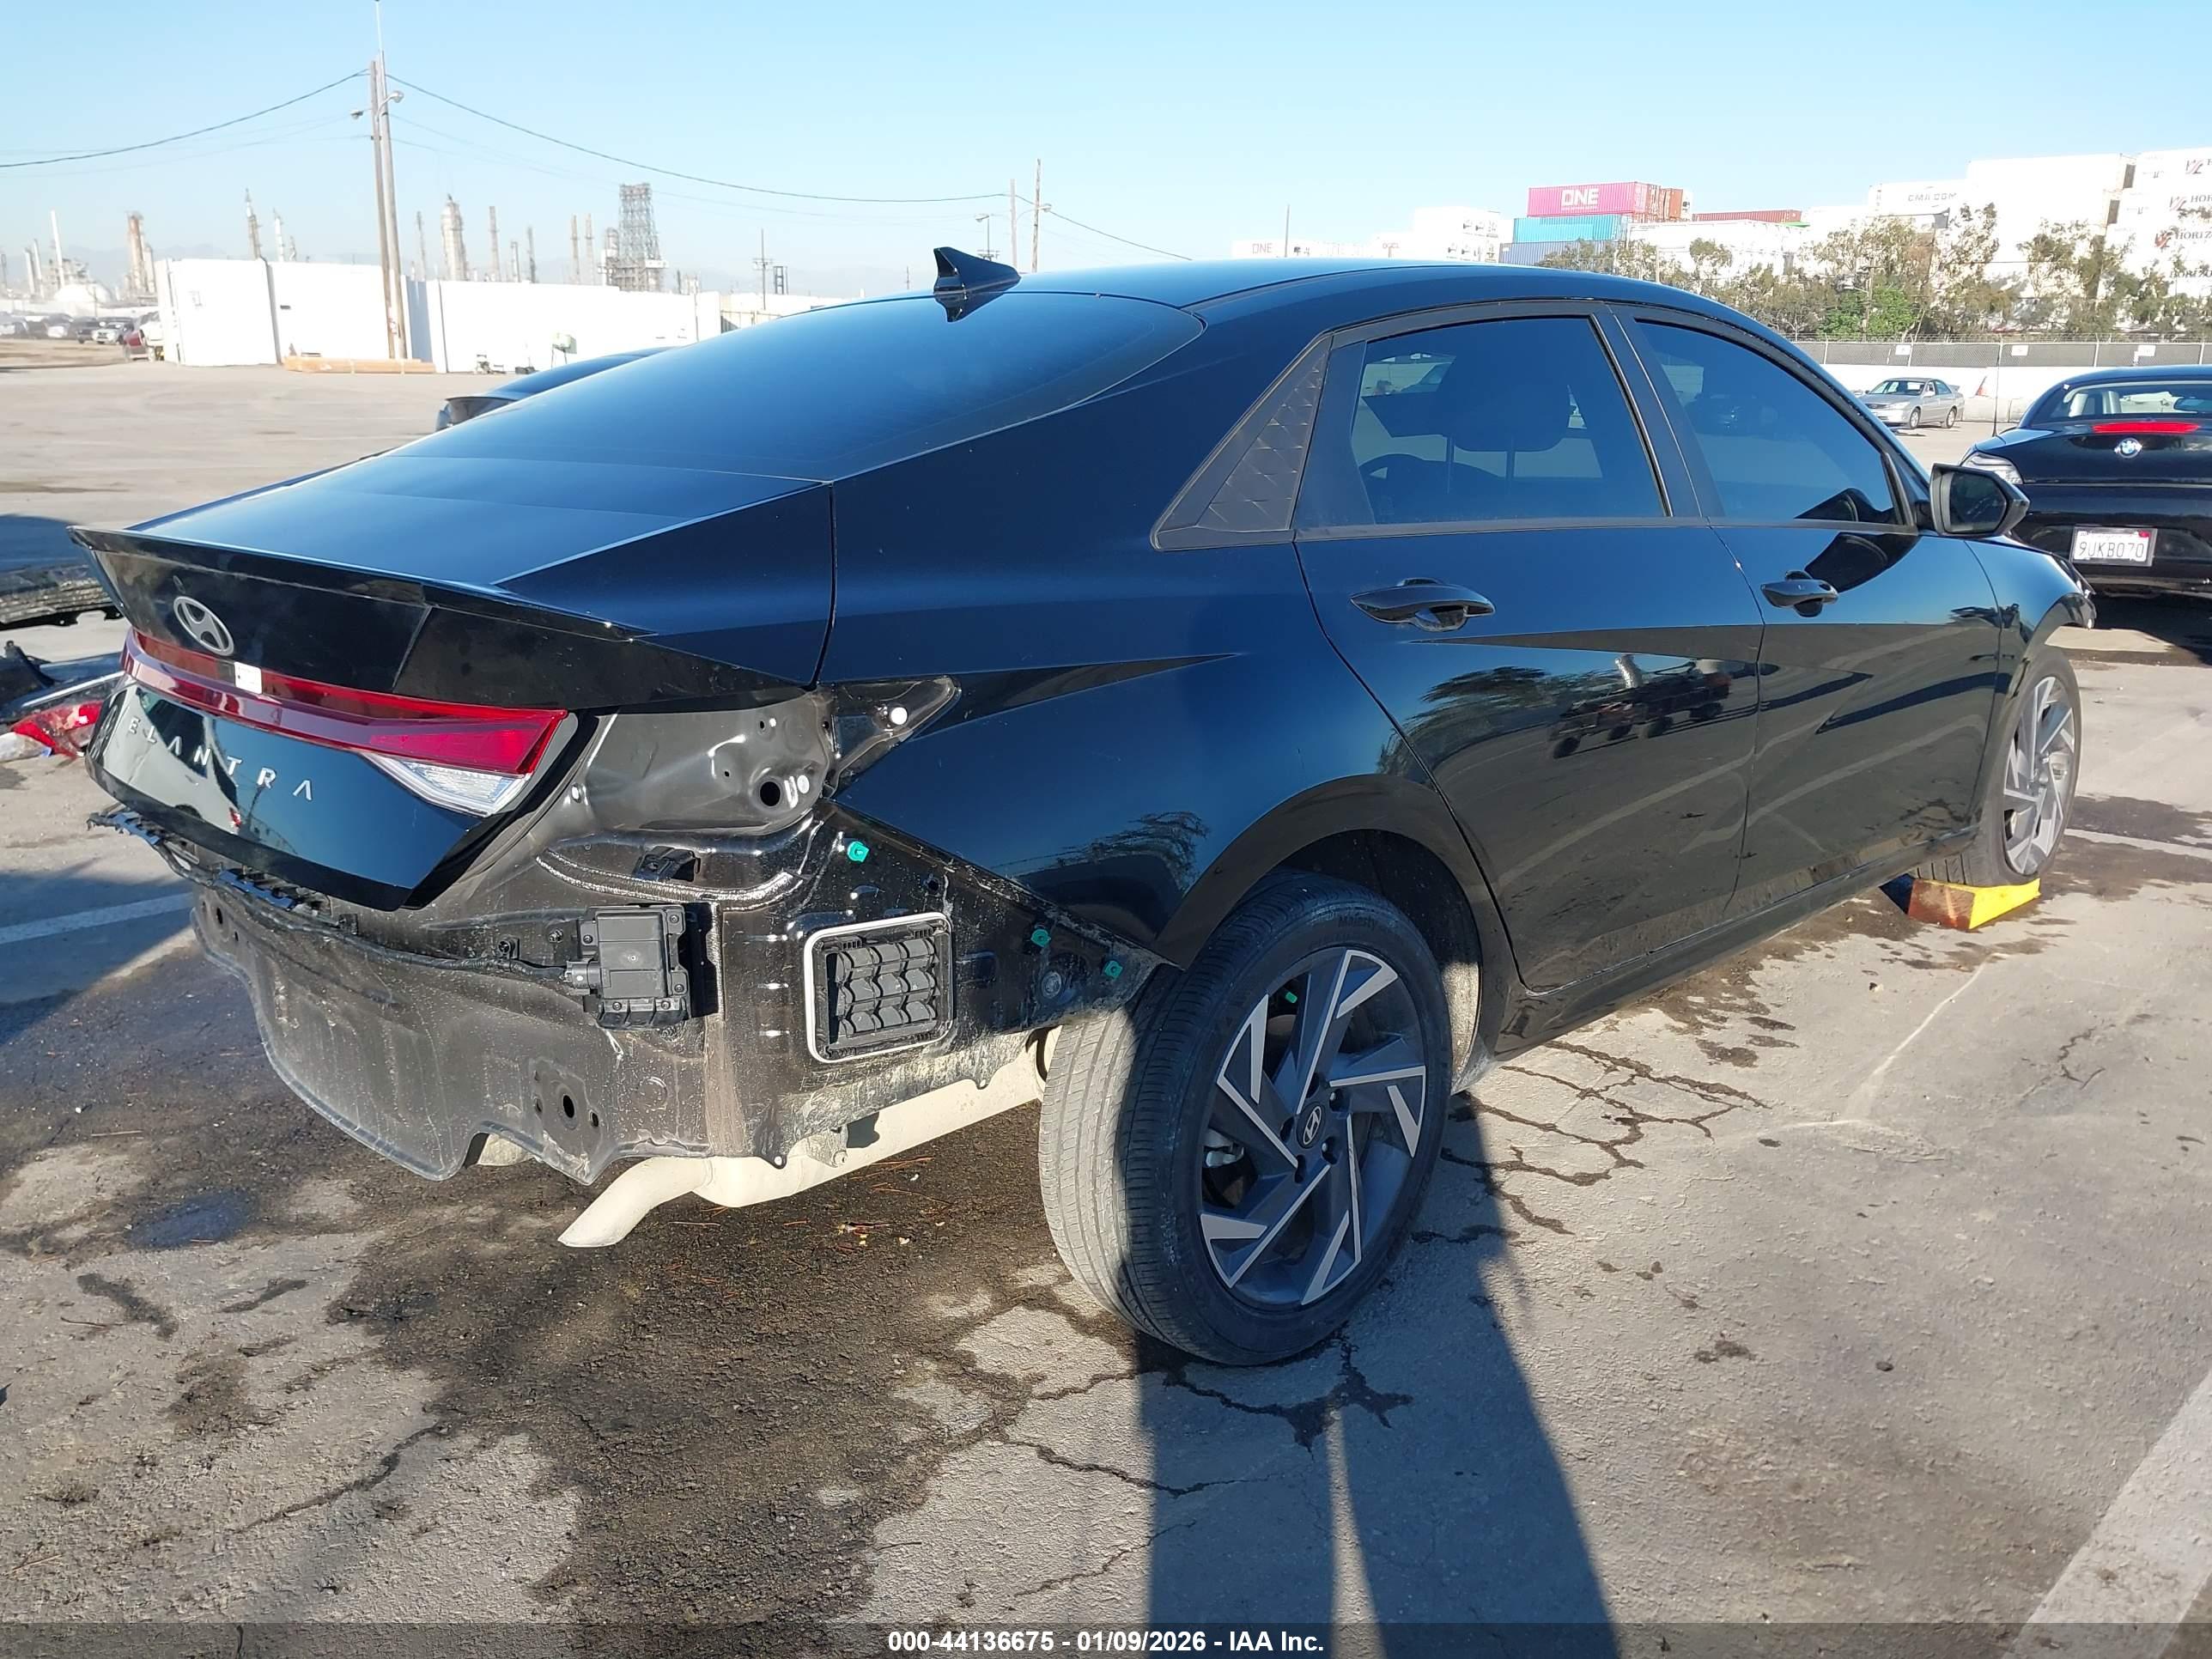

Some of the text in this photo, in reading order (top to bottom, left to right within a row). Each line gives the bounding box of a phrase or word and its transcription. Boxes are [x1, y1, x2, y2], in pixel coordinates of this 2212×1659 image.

[1561, 188, 1599, 206] ONE
[1252, 242, 1273, 254] ONE
[2079, 541, 2144, 557] 9UKB070
[129, 716, 313, 800] ELANTRA
